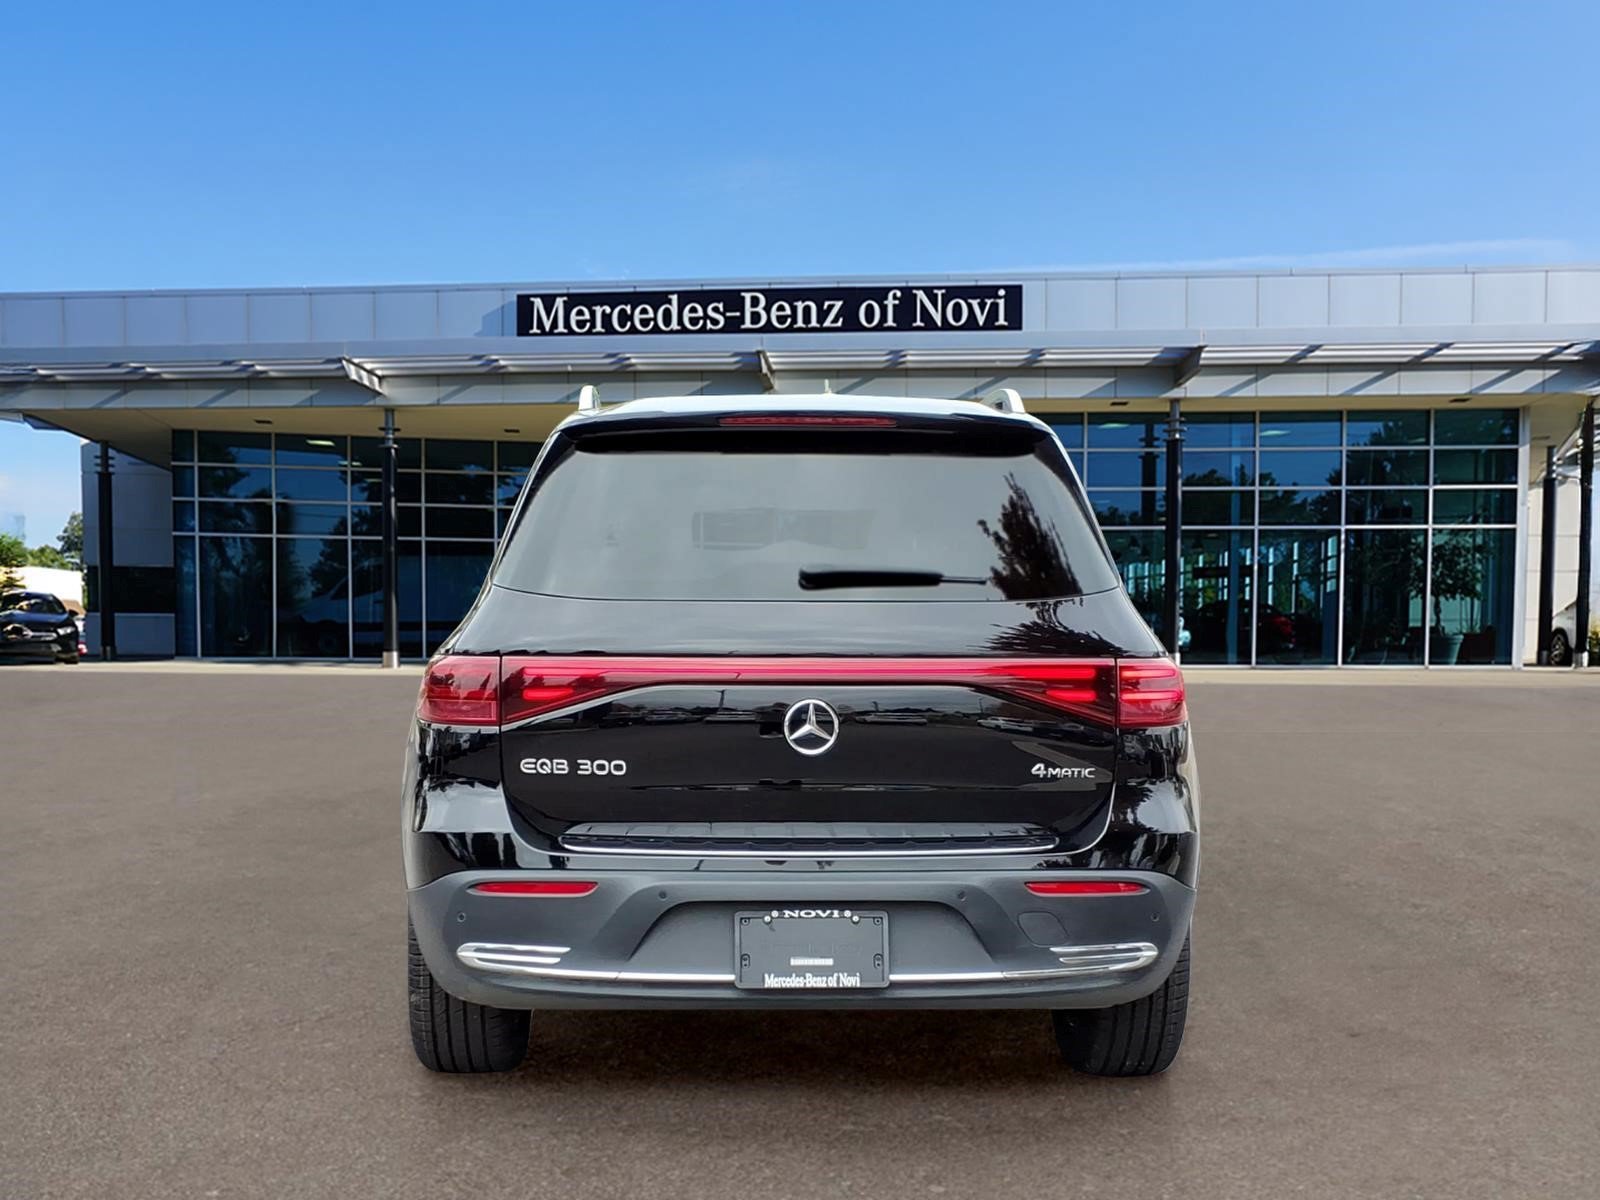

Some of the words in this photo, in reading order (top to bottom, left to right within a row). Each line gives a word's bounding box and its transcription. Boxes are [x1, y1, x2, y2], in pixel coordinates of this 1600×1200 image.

[529, 292, 844, 334] Mercedes-Benz
[858, 290, 901, 328] of
[912, 289, 1009, 327] Novi
[520, 758, 569, 774] EQB
[577, 759, 626, 776] 300
[1031, 763, 1096, 779] 4MATIC
[783, 909, 840, 918] NOVI
[764, 973, 828, 988] Mercedes-Benz
[828, 973, 838, 987] of
[839, 973, 861, 988] Novi
